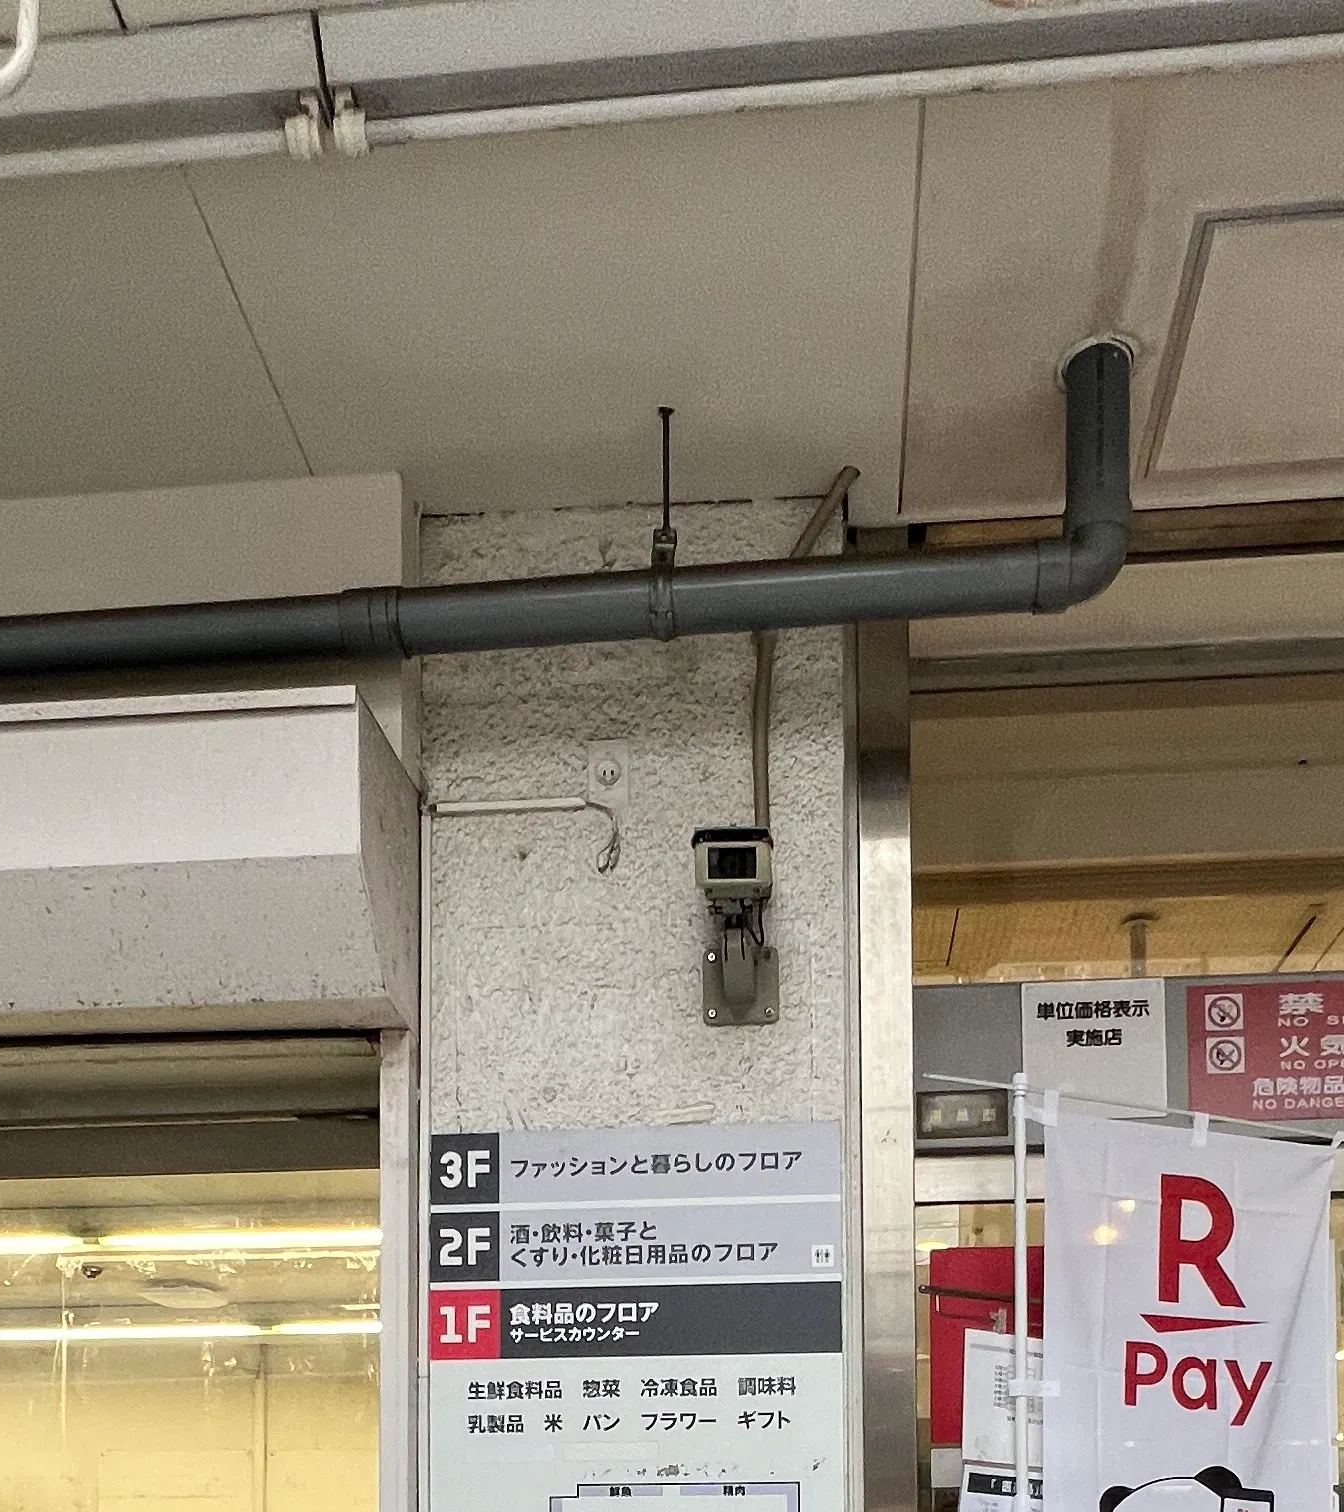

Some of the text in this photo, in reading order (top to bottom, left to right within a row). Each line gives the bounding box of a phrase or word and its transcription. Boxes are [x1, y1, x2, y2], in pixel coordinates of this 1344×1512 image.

[1036, 999, 1150, 1021] 単位価格表示
[1277, 1016, 1309, 1028] NO
[1065, 1028, 1123, 1048] 実施店
[1280, 1058, 1307, 1071] NO
[1252, 1098, 1279, 1111] NO
[439, 1150, 491, 1189] 3F
[510, 1151, 803, 1179] ファッションと暮らしのフロア
[509, 1221, 657, 1246] 酒・飲料・菓子と
[1158, 1172, 1247, 1309] R
[439, 1227, 491, 1267] 2F
[510, 1241, 779, 1267] くすり・化粧日用品のフロア
[439, 1305, 491, 1344] 1F
[509, 1302, 660, 1325] 食料品のフロア
[509, 1326, 640, 1344] サービスカウンター
[467, 1376, 797, 1400] 生鮮食料品 惣菜 冷凍食品 調味料
[1123, 1341, 1273, 1427] Pay
[467, 1411, 791, 1433] 乳製品 米 パン フラワー ギフト
